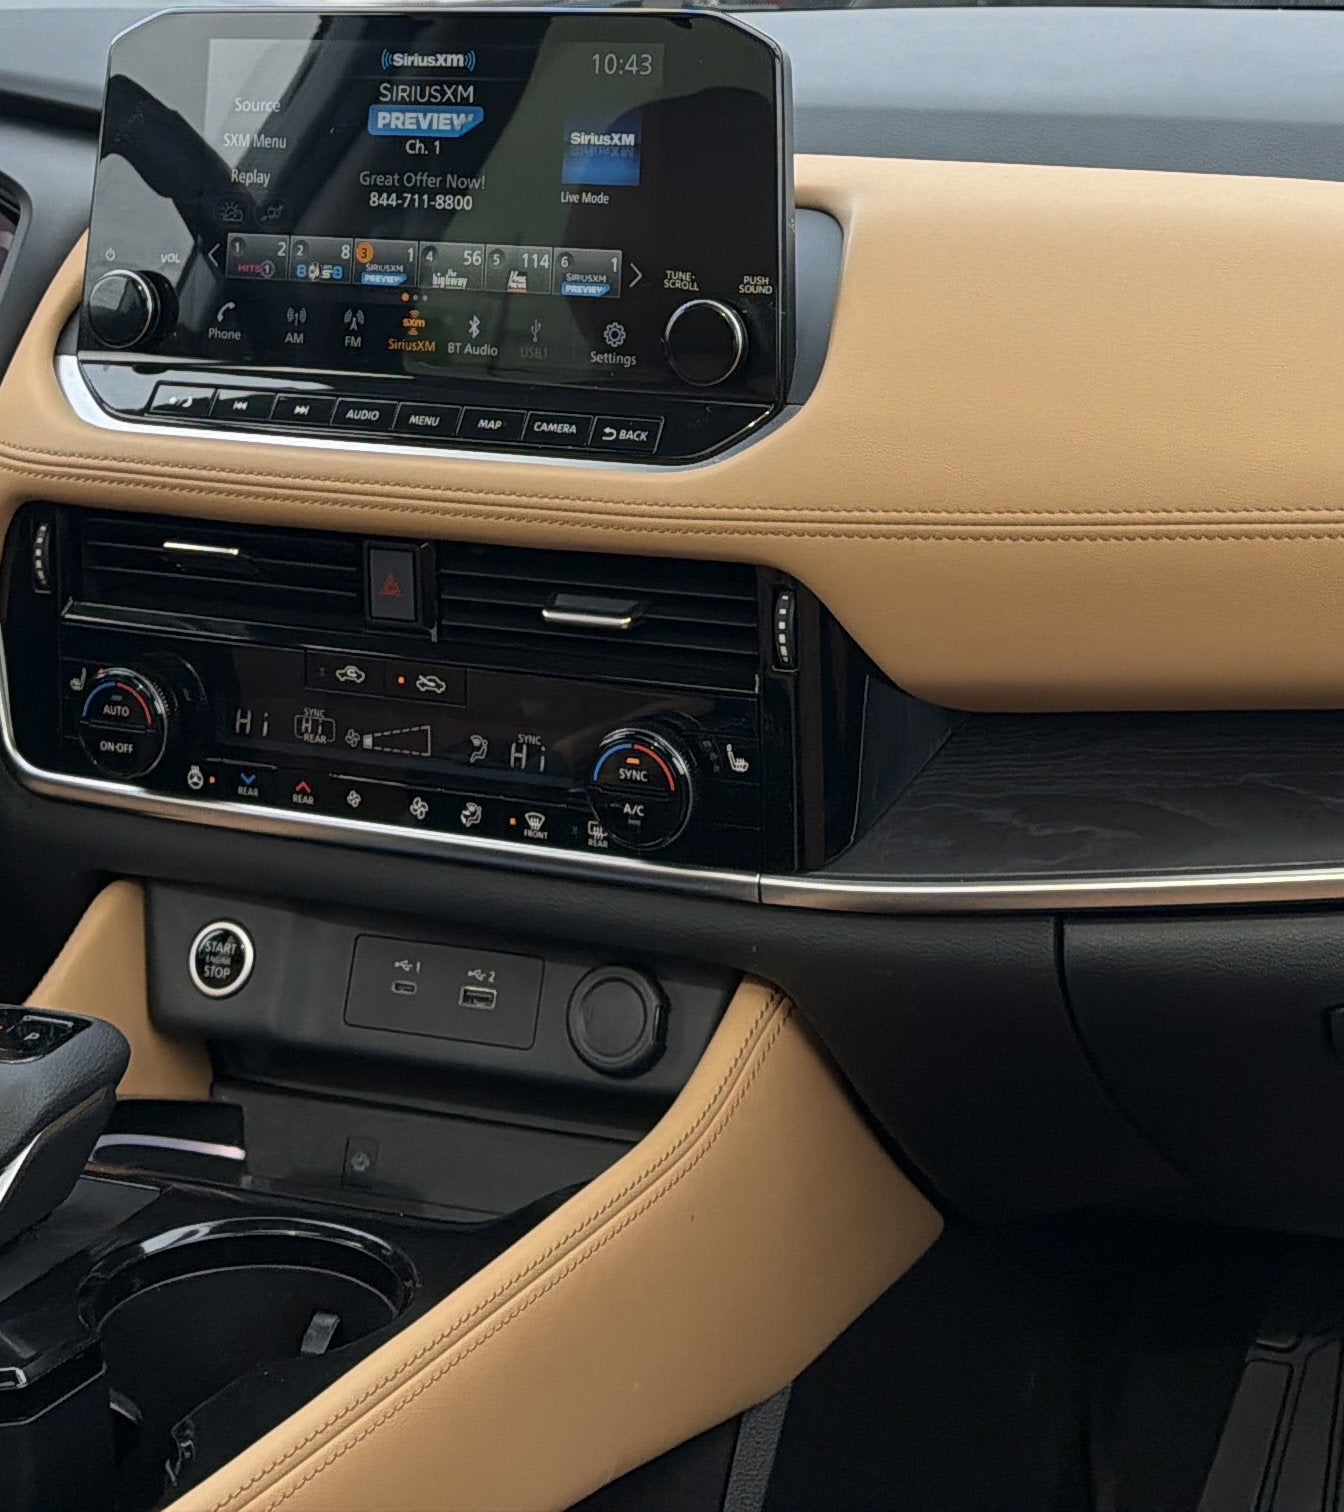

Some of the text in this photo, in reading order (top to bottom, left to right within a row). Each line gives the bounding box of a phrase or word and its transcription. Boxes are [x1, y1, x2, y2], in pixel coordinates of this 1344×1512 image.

[592, 53, 652, 75] 10:43
[379, 83, 474, 103] SIRIUSXM
[234, 97, 281, 113] Source
[377, 111, 474, 130] PREVIEW
[223, 132, 287, 149] SXM Menu
[570, 131, 635, 146] SiriusXM
[406, 139, 440, 155] Ch. 1
[231, 168, 271, 187] Replay
[359, 171, 486, 189] Great Offer Now!
[369, 191, 473, 211] 844-711-8800
[560, 191, 609, 204] Live Mode
[234, 241, 286, 257] 1 2
[296, 244, 351, 260] 2 8
[361, 247, 414, 262] 3 1
[160, 253, 181, 263] VOL
[425, 250, 482, 266] 4 56
[493, 253, 550, 269] 5 114
[560, 255, 618, 272] 6 1
[663, 279, 700, 291] SCROLL
[743, 275, 770, 285] PUSH
[739, 284, 773, 294] SOUND
[402, 317, 426, 328] sxm
[208, 327, 242, 341] Phone
[285, 332, 304, 344] AM
[344, 335, 362, 348] FM
[388, 338, 436, 352] SiriusXM
[447, 342, 499, 356] BT Audio
[590, 350, 637, 368] Settings
[346, 408, 380, 421] AUDIO
[408, 415, 440, 427] MENU
[477, 418, 503, 430] MAP
[533, 421, 577, 434] CAMERA
[618, 429, 649, 442] BACK
[102, 704, 130, 717] AUTO
[303, 707, 326, 718] SYNC
[303, 733, 327, 744] REAR
[517, 734, 542, 745] SYNC
[618, 767, 648, 782] SYNC
[237, 785, 259, 797] REAR
[292, 793, 314, 805] REAR
[623, 803, 645, 817] A/C
[523, 828, 549, 840] FRONT
[587, 838, 609, 848] REAR
[205, 940, 237, 955] START
[204, 965, 231, 979] STOP
[416, 961, 421, 973] 1
[488, 970, 496, 982] 2
[24, 1032, 41, 1040] P
